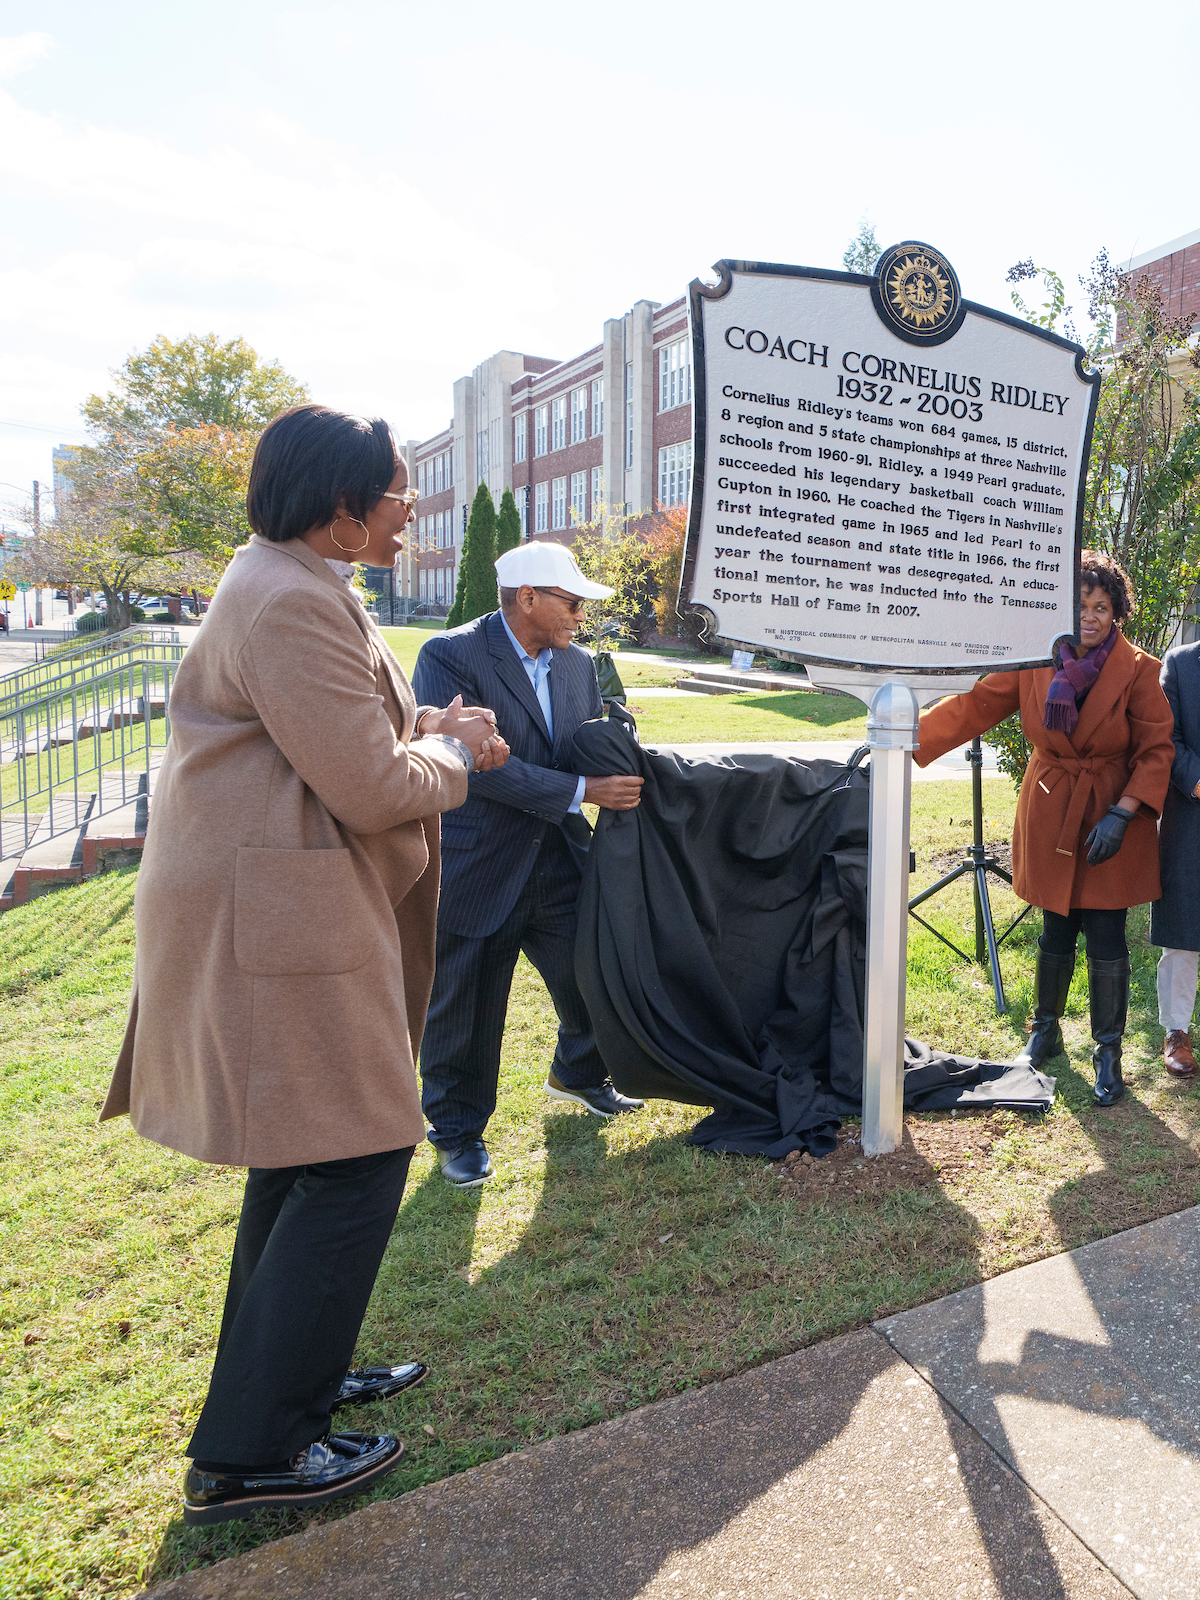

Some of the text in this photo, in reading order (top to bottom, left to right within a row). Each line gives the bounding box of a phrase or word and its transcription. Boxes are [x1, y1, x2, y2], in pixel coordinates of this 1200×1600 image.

[724, 326, 1070, 416] COACH CORNELIUS RIDLEY
[836, 375, 893, 406] 1932
[917, 393, 983, 422] 2003
[721, 408, 1067, 477] 8 region and 5 state championships at three Nashville
[722, 385, 790, 408] Cornelius
[797, 398, 852, 420] Ridley's
[856, 409, 893, 427] teams
[898, 419, 924, 432] won
[931, 423, 956, 438] 684
[1006, 437, 1018, 449] 15
[718, 457, 1063, 516] succeeded his legendary basketball coach William
[719, 433, 773, 451] schools
[778, 440, 812, 457] from
[930, 468, 937, 477] a
[944, 467, 973, 482] 1949
[977, 473, 1007, 488] Pearl
[717, 499, 1061, 554] first integrated game in 1965 and led Pearl to an
[718, 477, 1062, 535] Gupton in 1960. He coached the Tigers in Nashville's
[714, 547, 1059, 591] year the tournament was desegregated. An educa-
[716, 525, 801, 543] undefeated
[807, 535, 851, 549] season
[858, 541, 882, 552] and
[889, 543, 922, 556] state
[927, 547, 954, 560] title
[959, 551, 970, 562] in
[1012, 557, 1031, 569] the
[1035, 560, 1060, 572] first
[713, 588, 920, 617] Sports Hall of Fame in 2007.
[714, 566, 758, 582] tional
[826, 577, 843, 589] he
[849, 582, 874, 592] was
[880, 583, 937, 599] inducted
[943, 589, 967, 602] into
[973, 592, 994, 604] the
[1001, 595, 1057, 611] Tennessee
[780, 629, 816, 637] HISTORICAL
[819, 632, 857, 640] COMMISSION
[871, 635, 915, 644] METROPOLITAN
[917, 639, 947, 647] NASHVILLE
